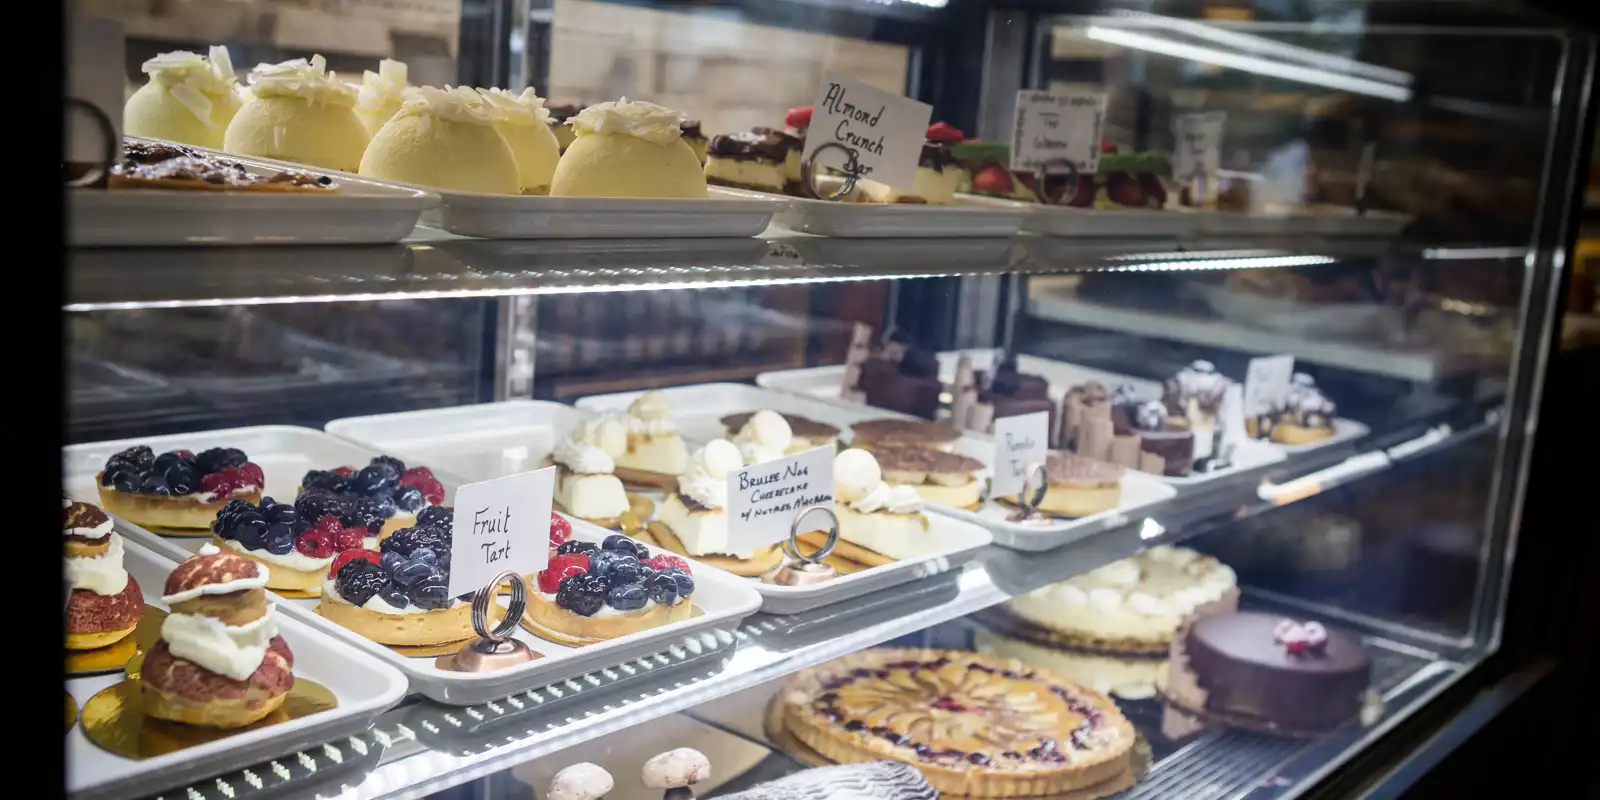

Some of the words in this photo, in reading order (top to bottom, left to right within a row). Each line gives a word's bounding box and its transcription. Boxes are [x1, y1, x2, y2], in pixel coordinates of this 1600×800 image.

[822, 82, 886, 127] Almond
[835, 119, 884, 156] Crunch
[843, 148, 874, 175] Bar
[472, 506, 511, 535] Fruit
[481, 540, 511, 564] Tart
